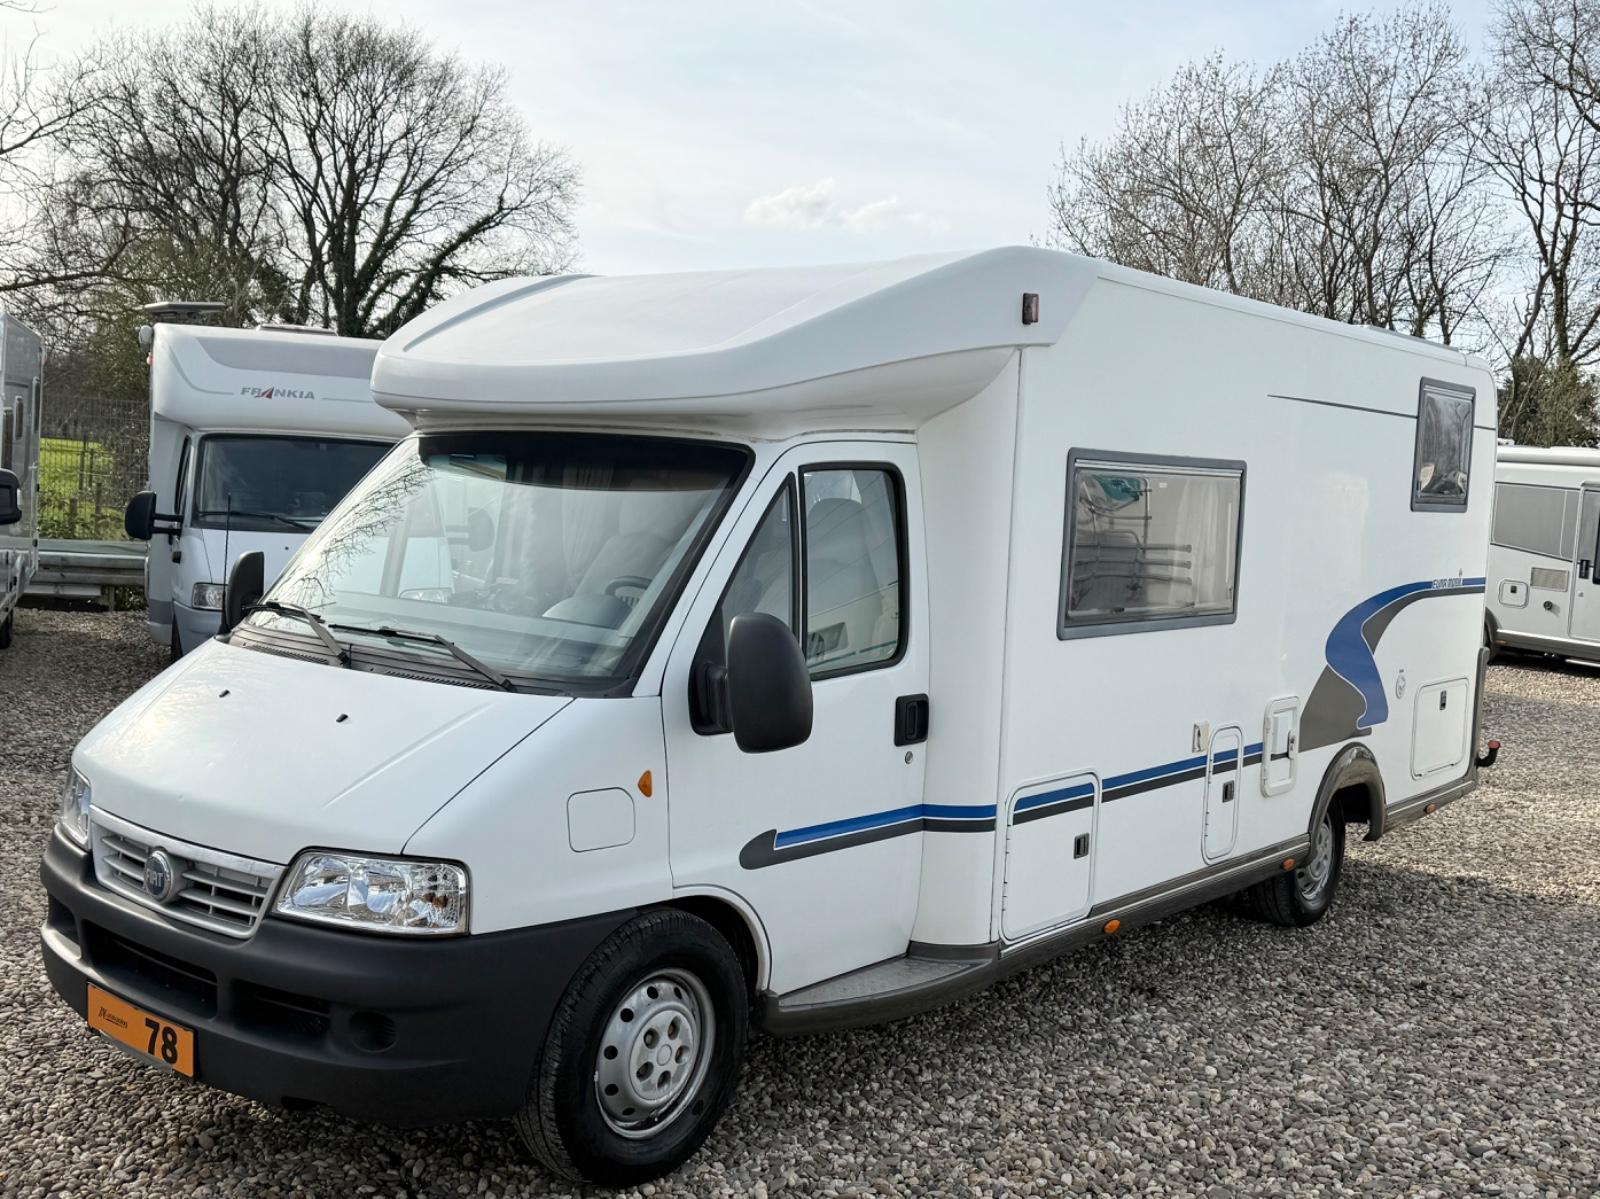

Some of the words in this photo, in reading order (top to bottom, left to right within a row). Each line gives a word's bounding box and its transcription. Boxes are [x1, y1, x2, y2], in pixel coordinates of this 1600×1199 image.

[240, 386, 315, 400] FRANKIA
[145, 868, 164, 888] FIAT
[145, 1017, 178, 1064] 78
